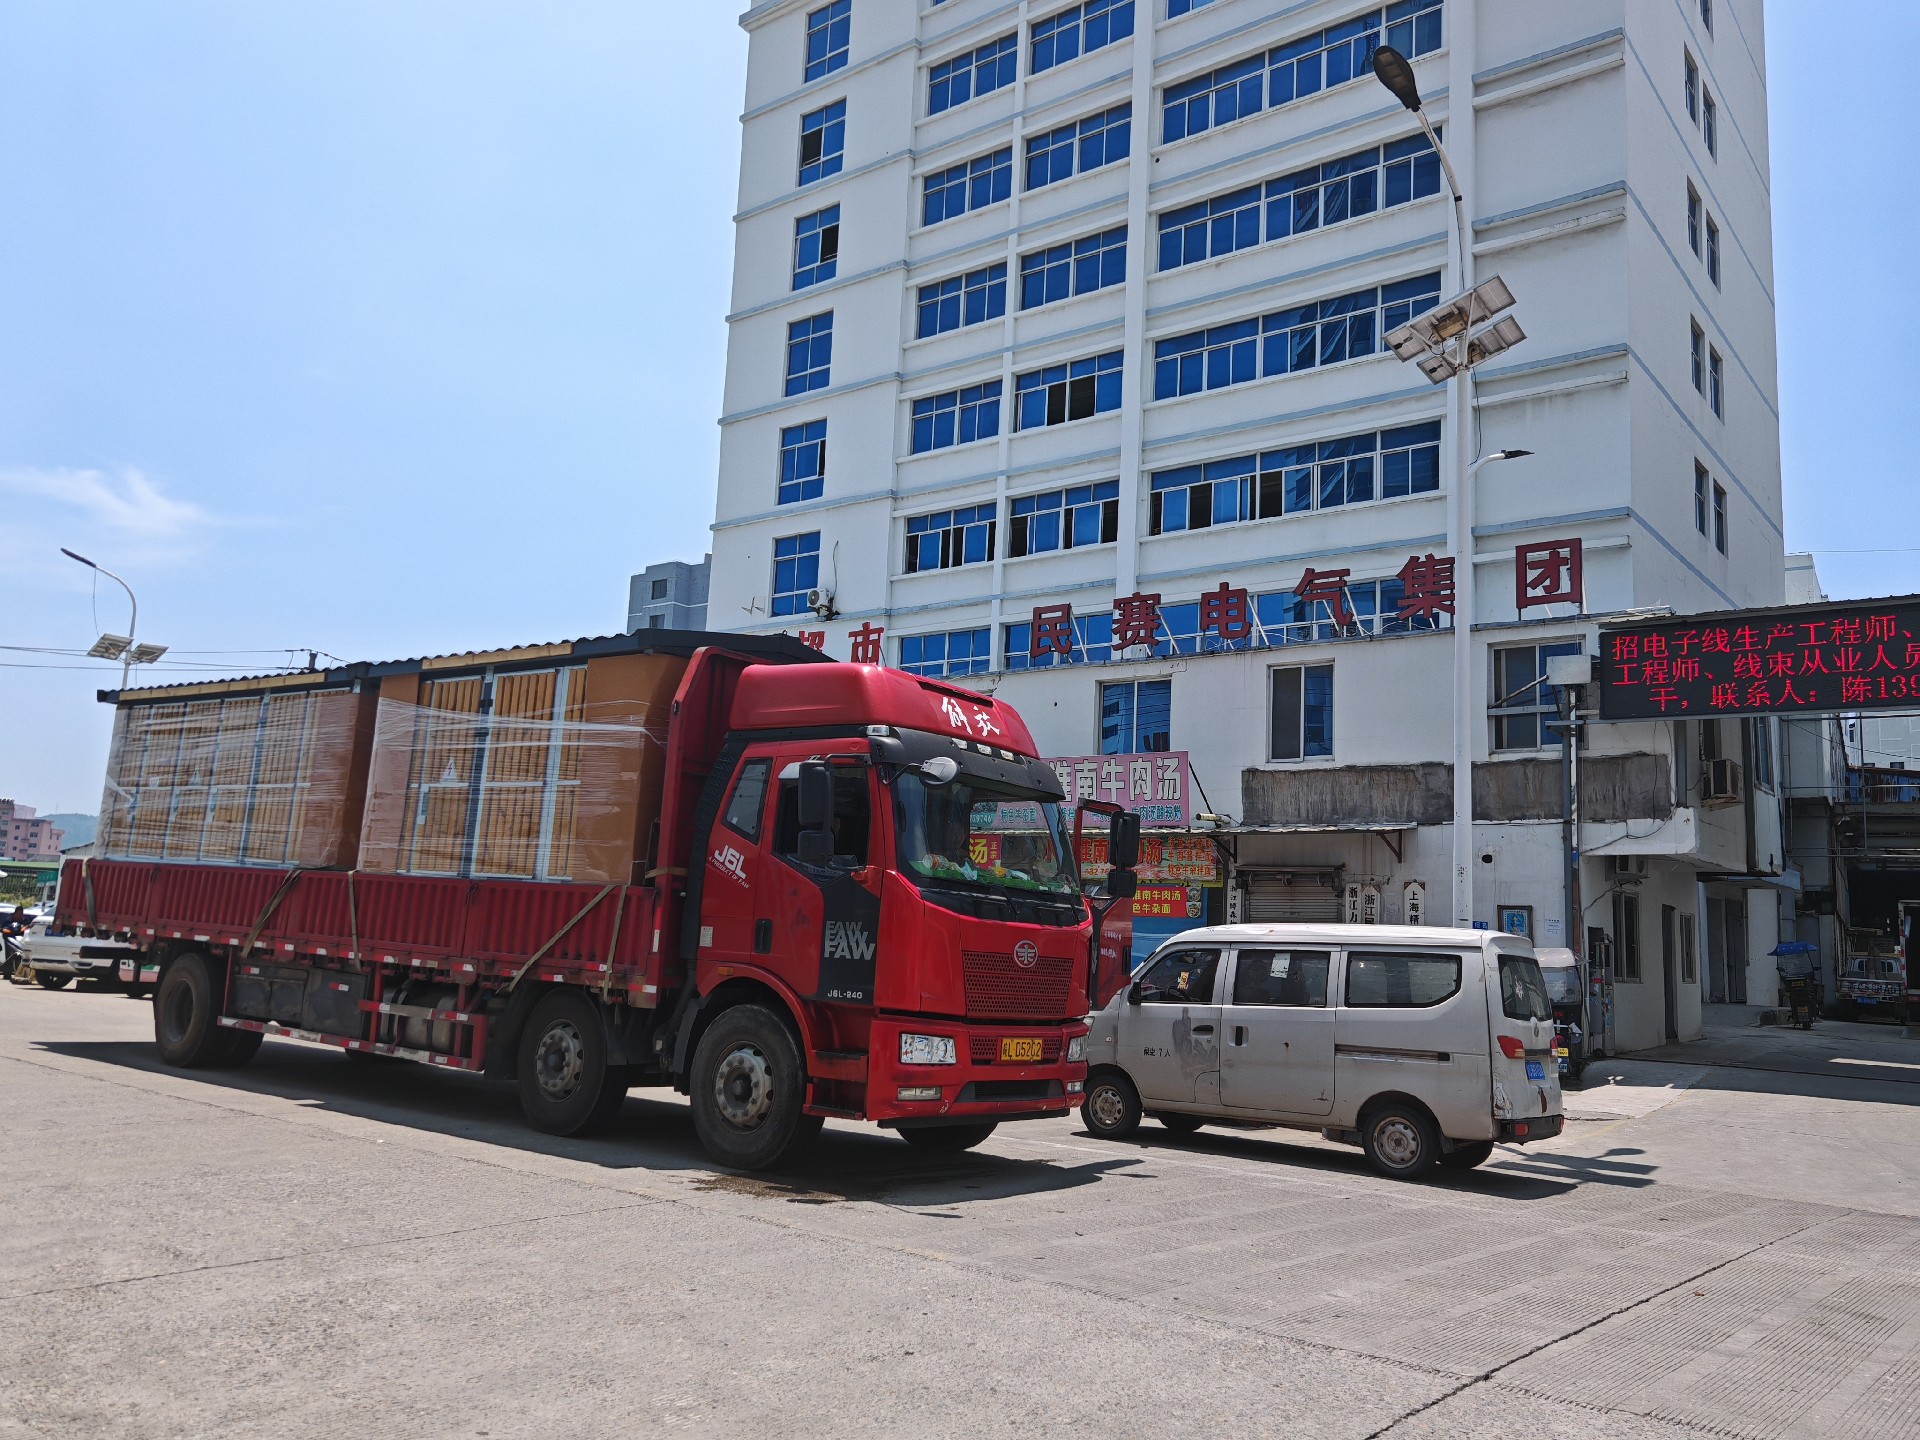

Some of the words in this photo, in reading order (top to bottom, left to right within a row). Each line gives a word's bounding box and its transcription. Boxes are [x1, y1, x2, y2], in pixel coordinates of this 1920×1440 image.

[1030, 538, 1584, 658] 民赛电气集团
[714, 844, 747, 880] J6L
[824, 942, 876, 961] FAW
